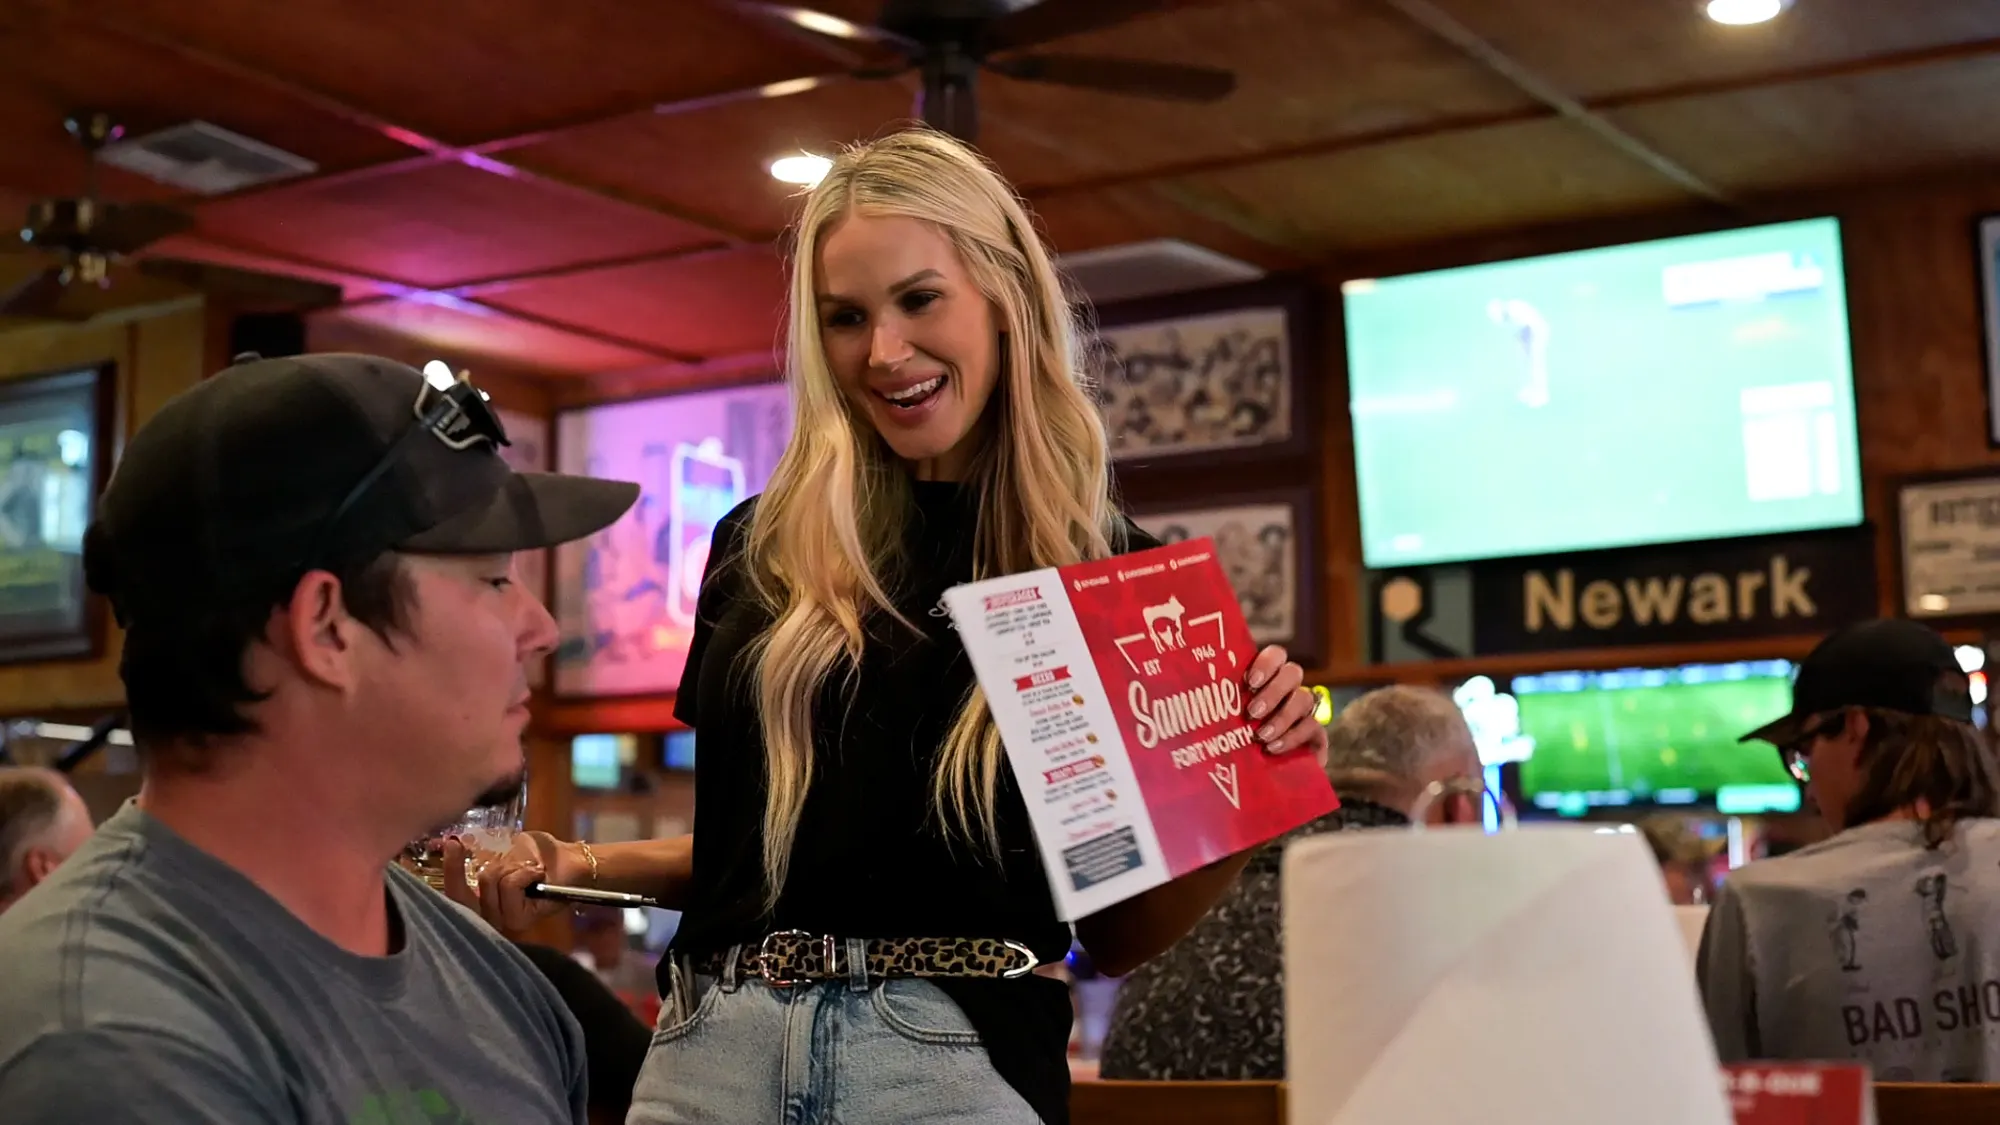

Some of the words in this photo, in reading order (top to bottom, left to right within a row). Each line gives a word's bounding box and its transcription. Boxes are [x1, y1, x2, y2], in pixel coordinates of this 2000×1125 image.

[1522, 554, 1817, 632] Newark
[1143, 659, 1162, 677] EST
[1191, 644, 1216, 663] 1946
[1171, 743, 1206, 769] FORT
[1203, 725, 1254, 758] WORTH
[1842, 997, 1922, 1047] BAD
[1934, 980, 2000, 1031] SHO
